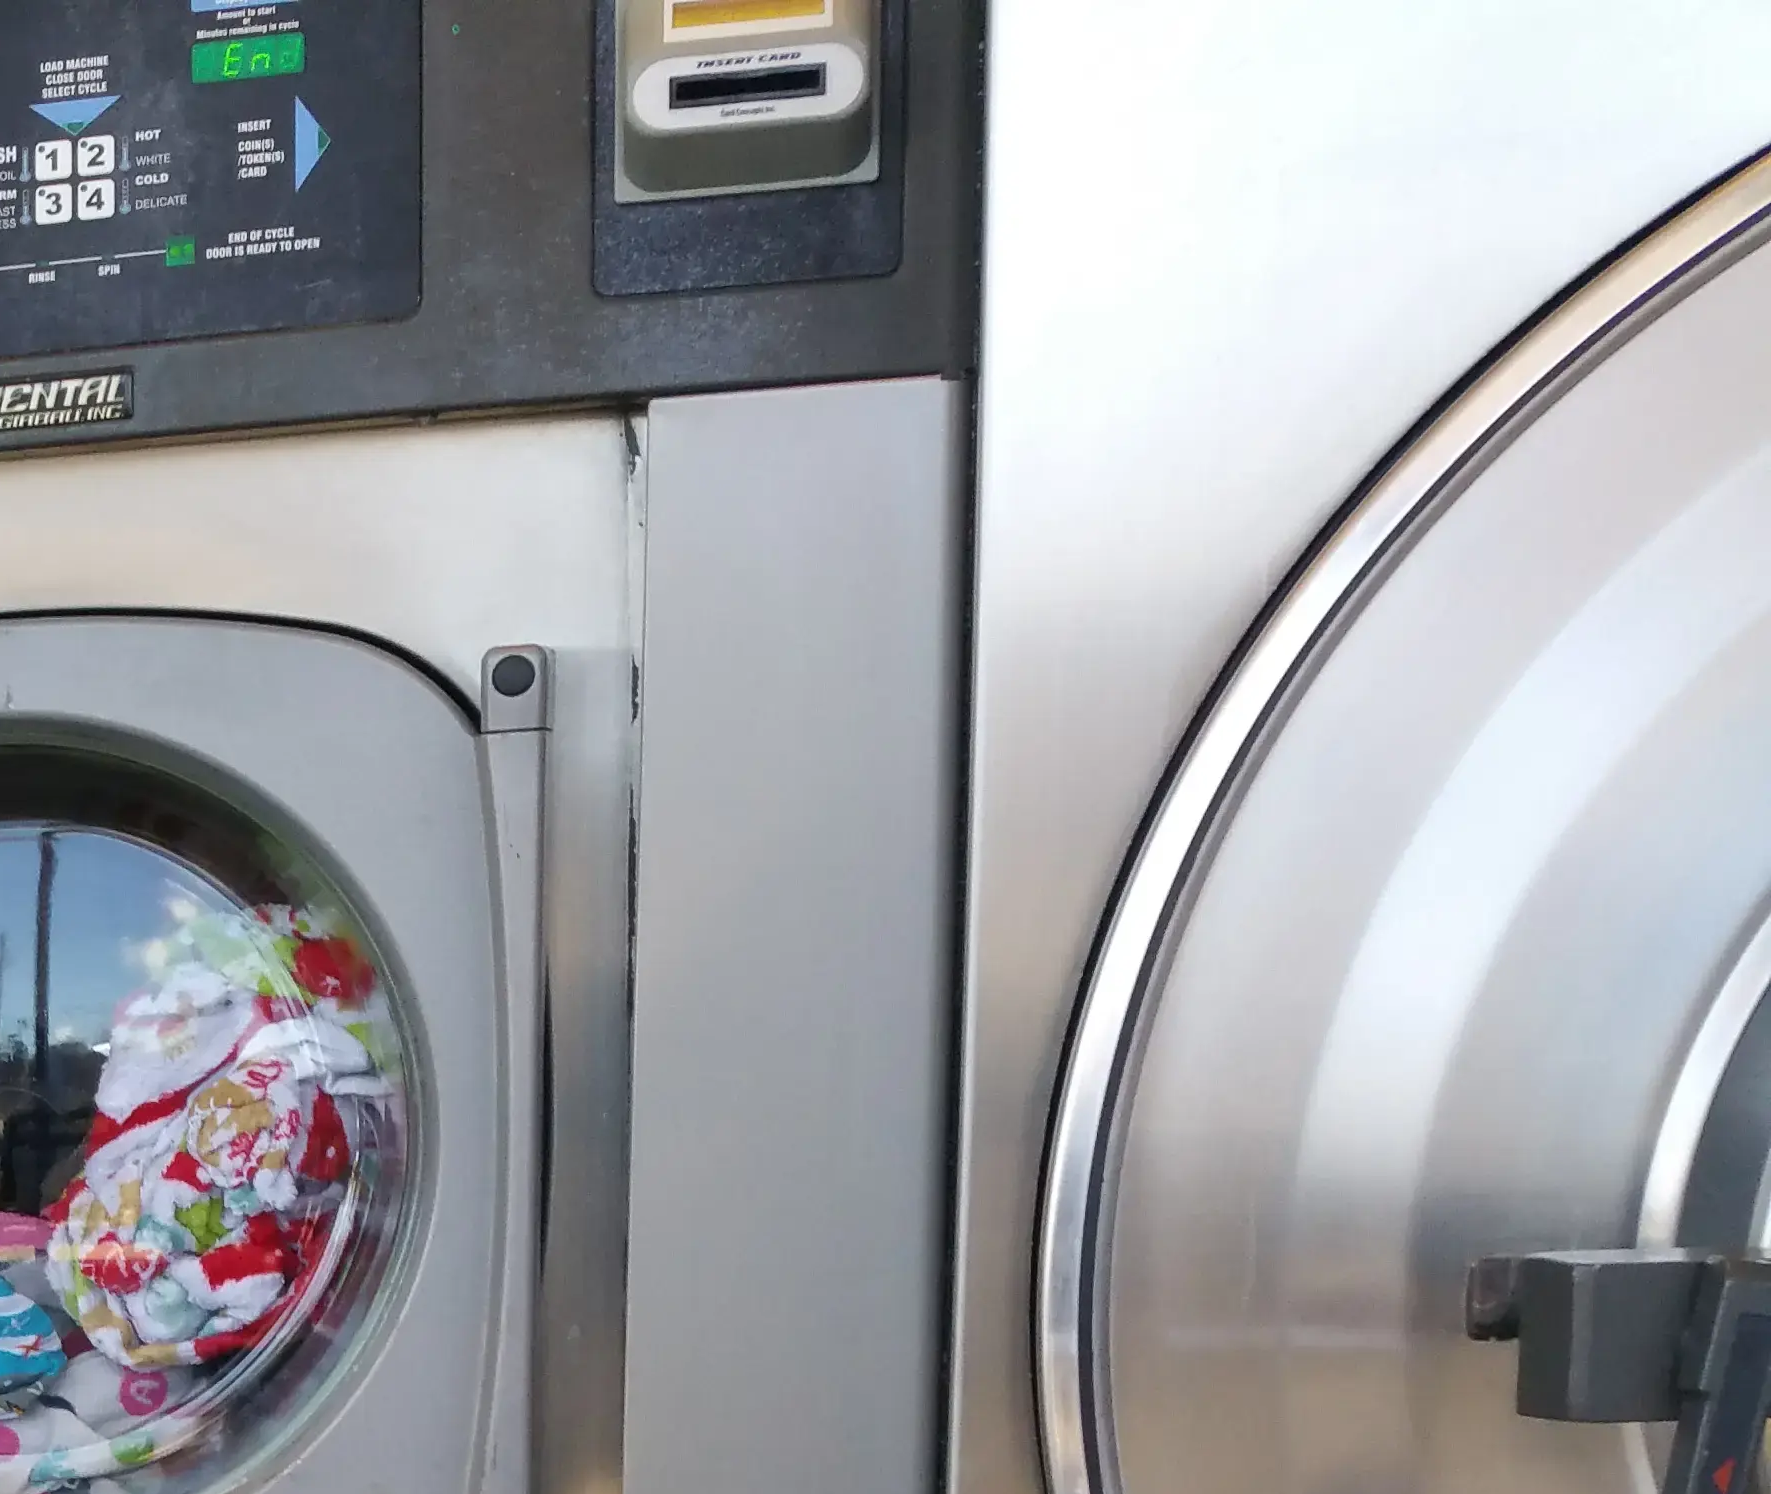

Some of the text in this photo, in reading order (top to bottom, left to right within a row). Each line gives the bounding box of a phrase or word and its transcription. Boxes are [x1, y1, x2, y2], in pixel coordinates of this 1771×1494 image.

[217, 5, 276, 20] Amount to start
[196, 28, 228, 40] Minutes
[229, 24, 268, 36] remaining
[279, 19, 300, 31] cycle
[40, 55, 109, 73] LOAD MACHINE
[696, 52, 801, 69] INSERT CARD
[46, 69, 103, 85] CLOSE DOOR
[41, 81, 108, 99] SELECT CYCLE
[237, 119, 272, 133] INSERT
[135, 129, 162, 142] HOT
[238, 138, 275, 152] COIN(S)
[45, 144, 105, 172] 1 2
[135, 153, 171, 167] WHITE
[237, 151, 285, 167] /TOKEN(S)
[135, 173, 170, 187] COLD
[237, 166, 268, 180] /CARD
[46, 188, 105, 216] 3 4
[135, 194, 188, 210] DELICATE
[228, 226, 295, 245] END OF CYCLE
[205, 237, 320, 260] DOOR IS READY TO OPEN
[29, 270, 56, 285] RINSE
[98, 264, 120, 277] SPIN
